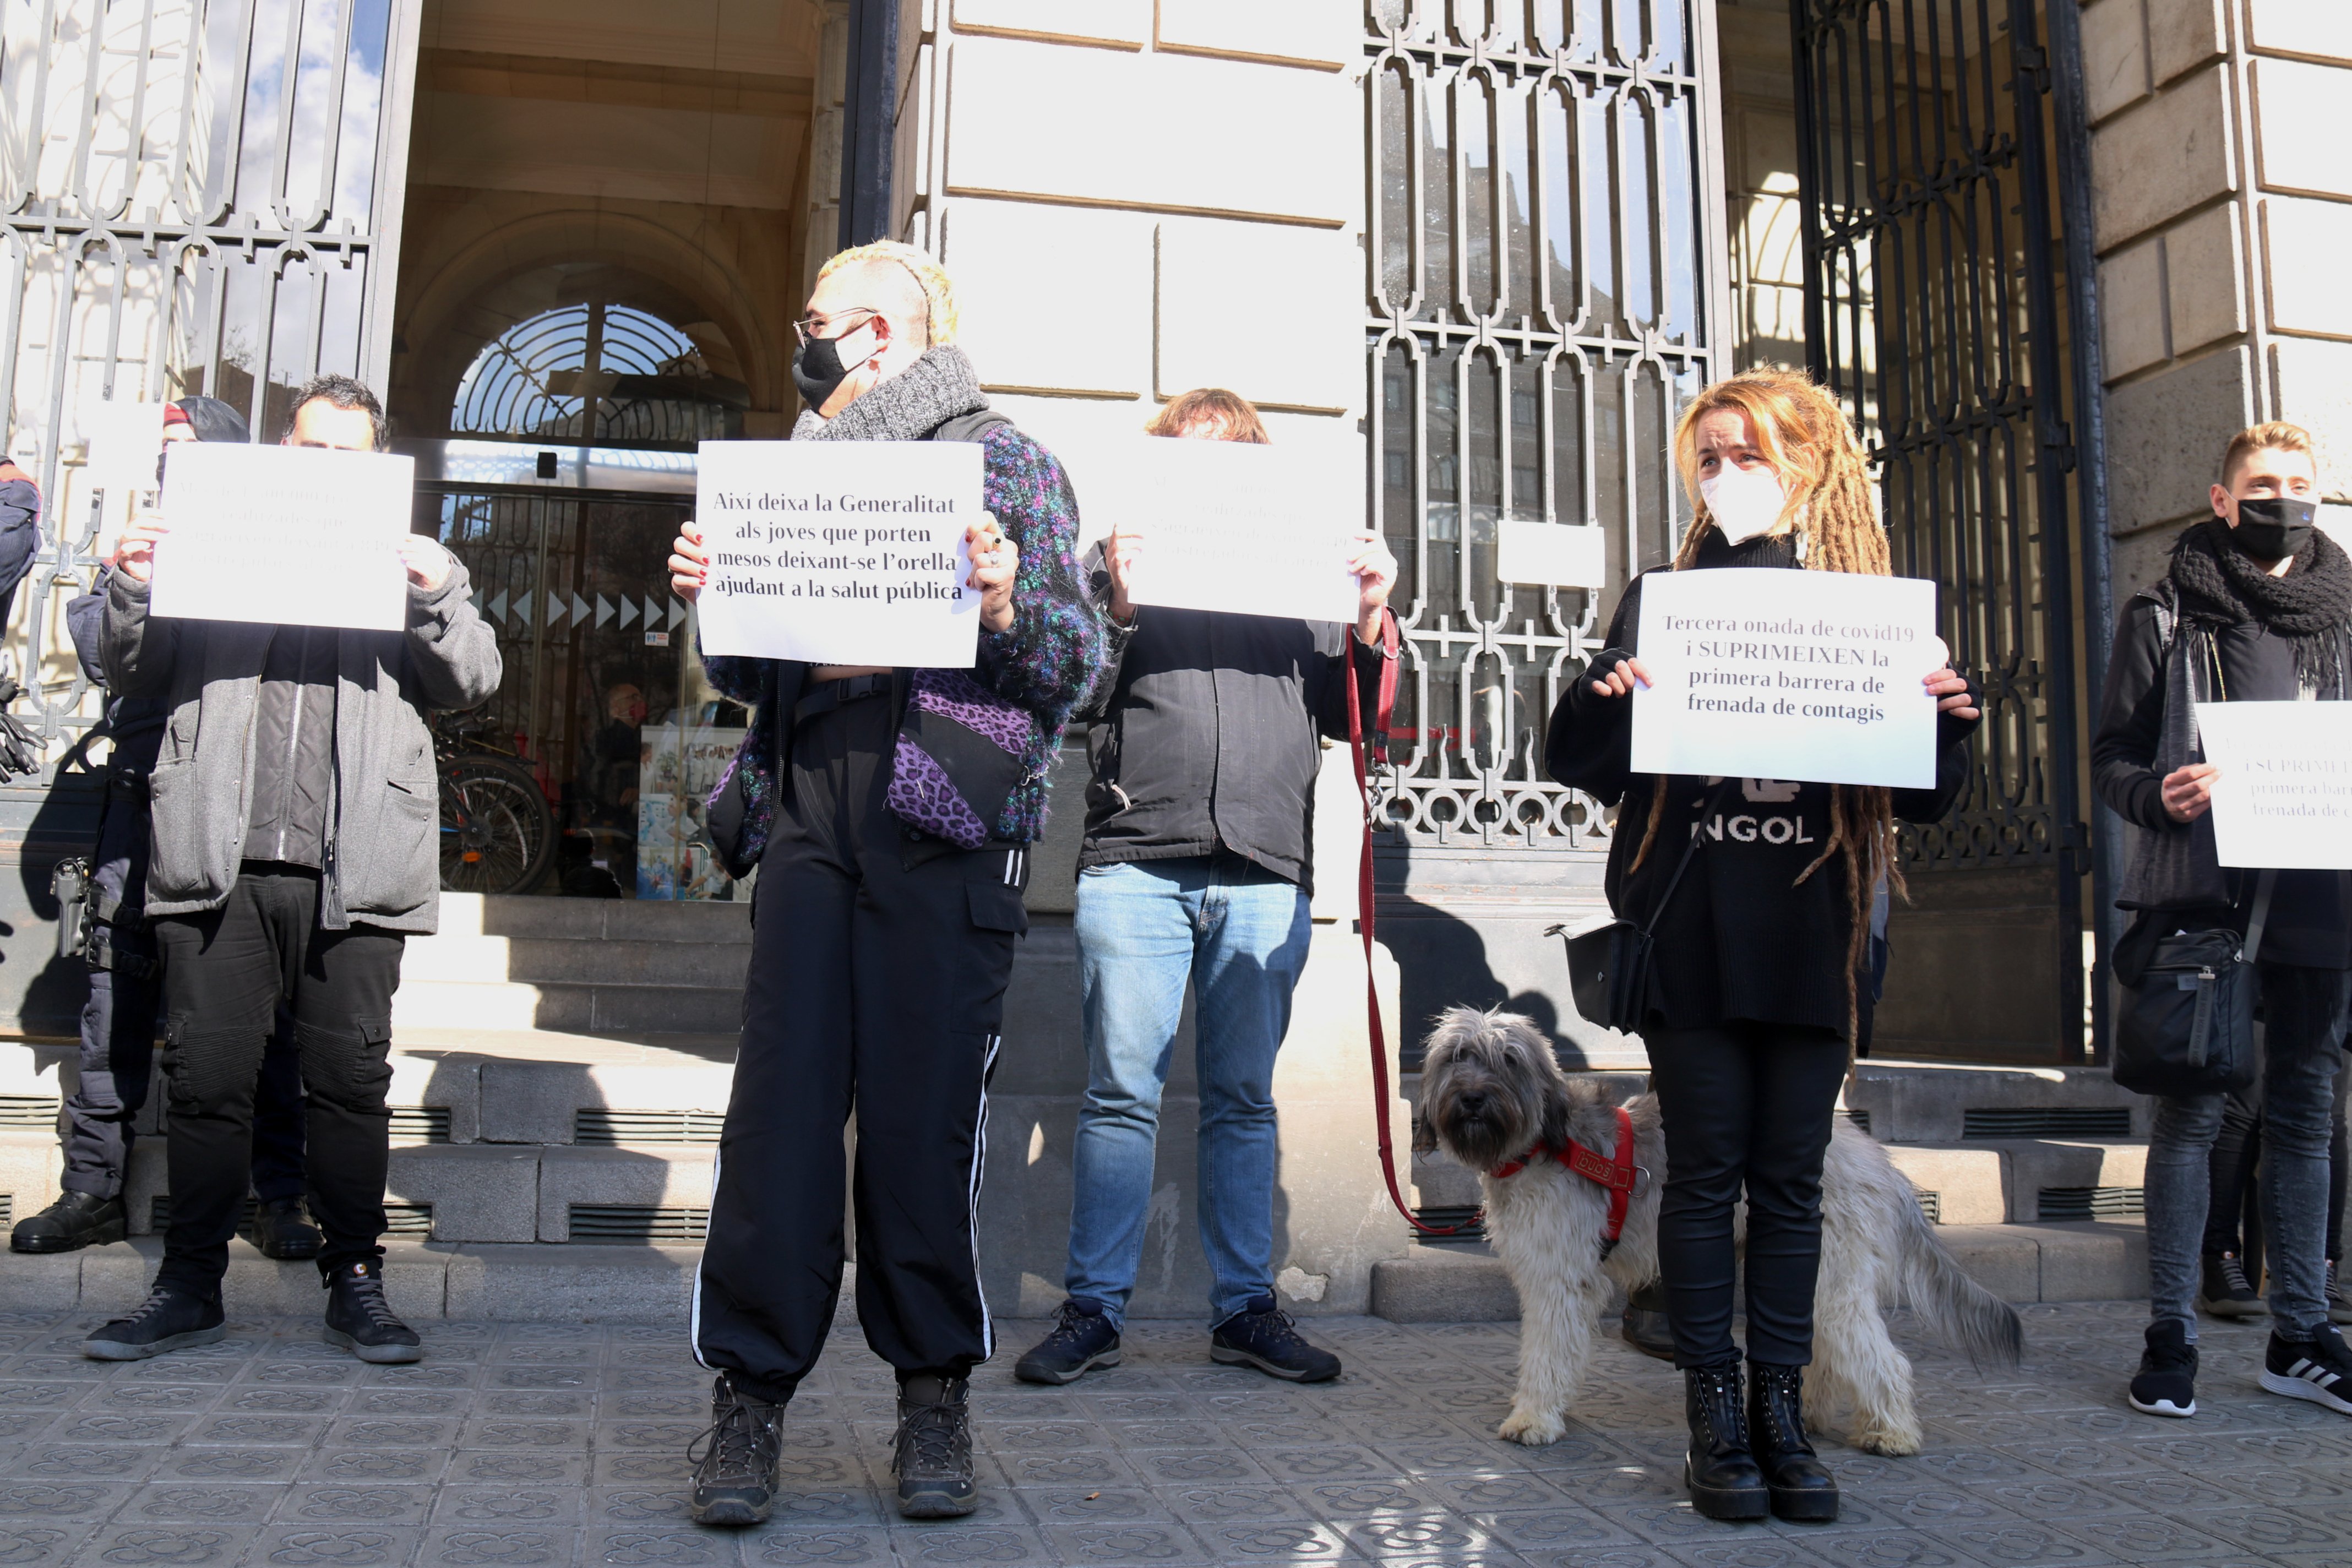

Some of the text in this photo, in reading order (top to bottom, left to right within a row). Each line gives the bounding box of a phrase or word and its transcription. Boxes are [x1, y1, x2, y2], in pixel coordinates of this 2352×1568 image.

[714, 493, 954, 513] Així deixa la Generalitat
[736, 521, 931, 546] als joves que porten
[718, 551, 956, 571] mesos deixant-se l'orella
[716, 575, 962, 603] ajudant a la salut pública
[1663, 616, 1913, 641] Tercera onada de covid19
[1687, 640, 1888, 667] i SUPRIMEIXEN la
[1689, 668, 1884, 693] primera barrera de
[1688, 693, 1884, 725] frenada de contagis
[2251, 780, 2317, 797] primera
[2322, 803, 2339, 817] de
